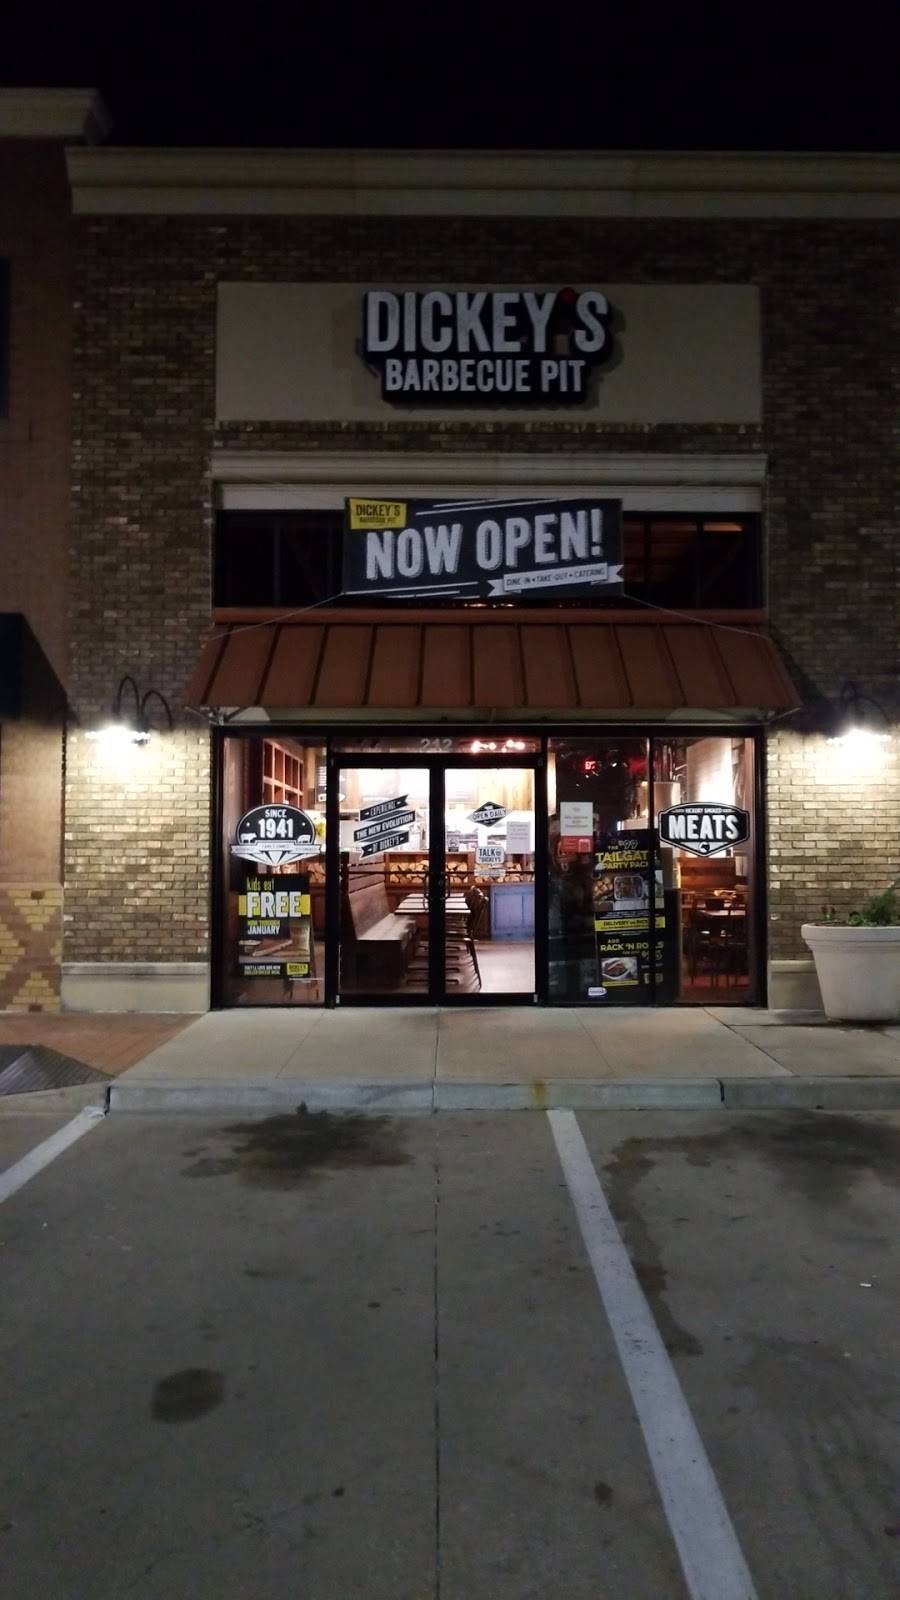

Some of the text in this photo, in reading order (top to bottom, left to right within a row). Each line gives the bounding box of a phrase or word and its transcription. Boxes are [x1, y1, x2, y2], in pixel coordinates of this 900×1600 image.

[367, 290, 608, 353] DICKEY'S
[385, 359, 586, 392] BARBECUE PIT
[356, 504, 401, 517] DICKEY'S
[365, 508, 603, 581] NOW OPEN!
[265, 808, 287, 818] SINCE
[473, 808, 507, 821] OPEN DAILY
[258, 818, 294, 839] 1941
[356, 813, 414, 840] THE NEW EVOLUTION
[668, 814, 739, 840] MEATS
[479, 848, 496, 857] TALK
[595, 850, 657, 863] TAILGAT
[247, 877, 261, 891] kids
[247, 891, 302, 918] FREE
[247, 925, 280, 935] JANUARY
[600, 943, 624, 951] RACK
